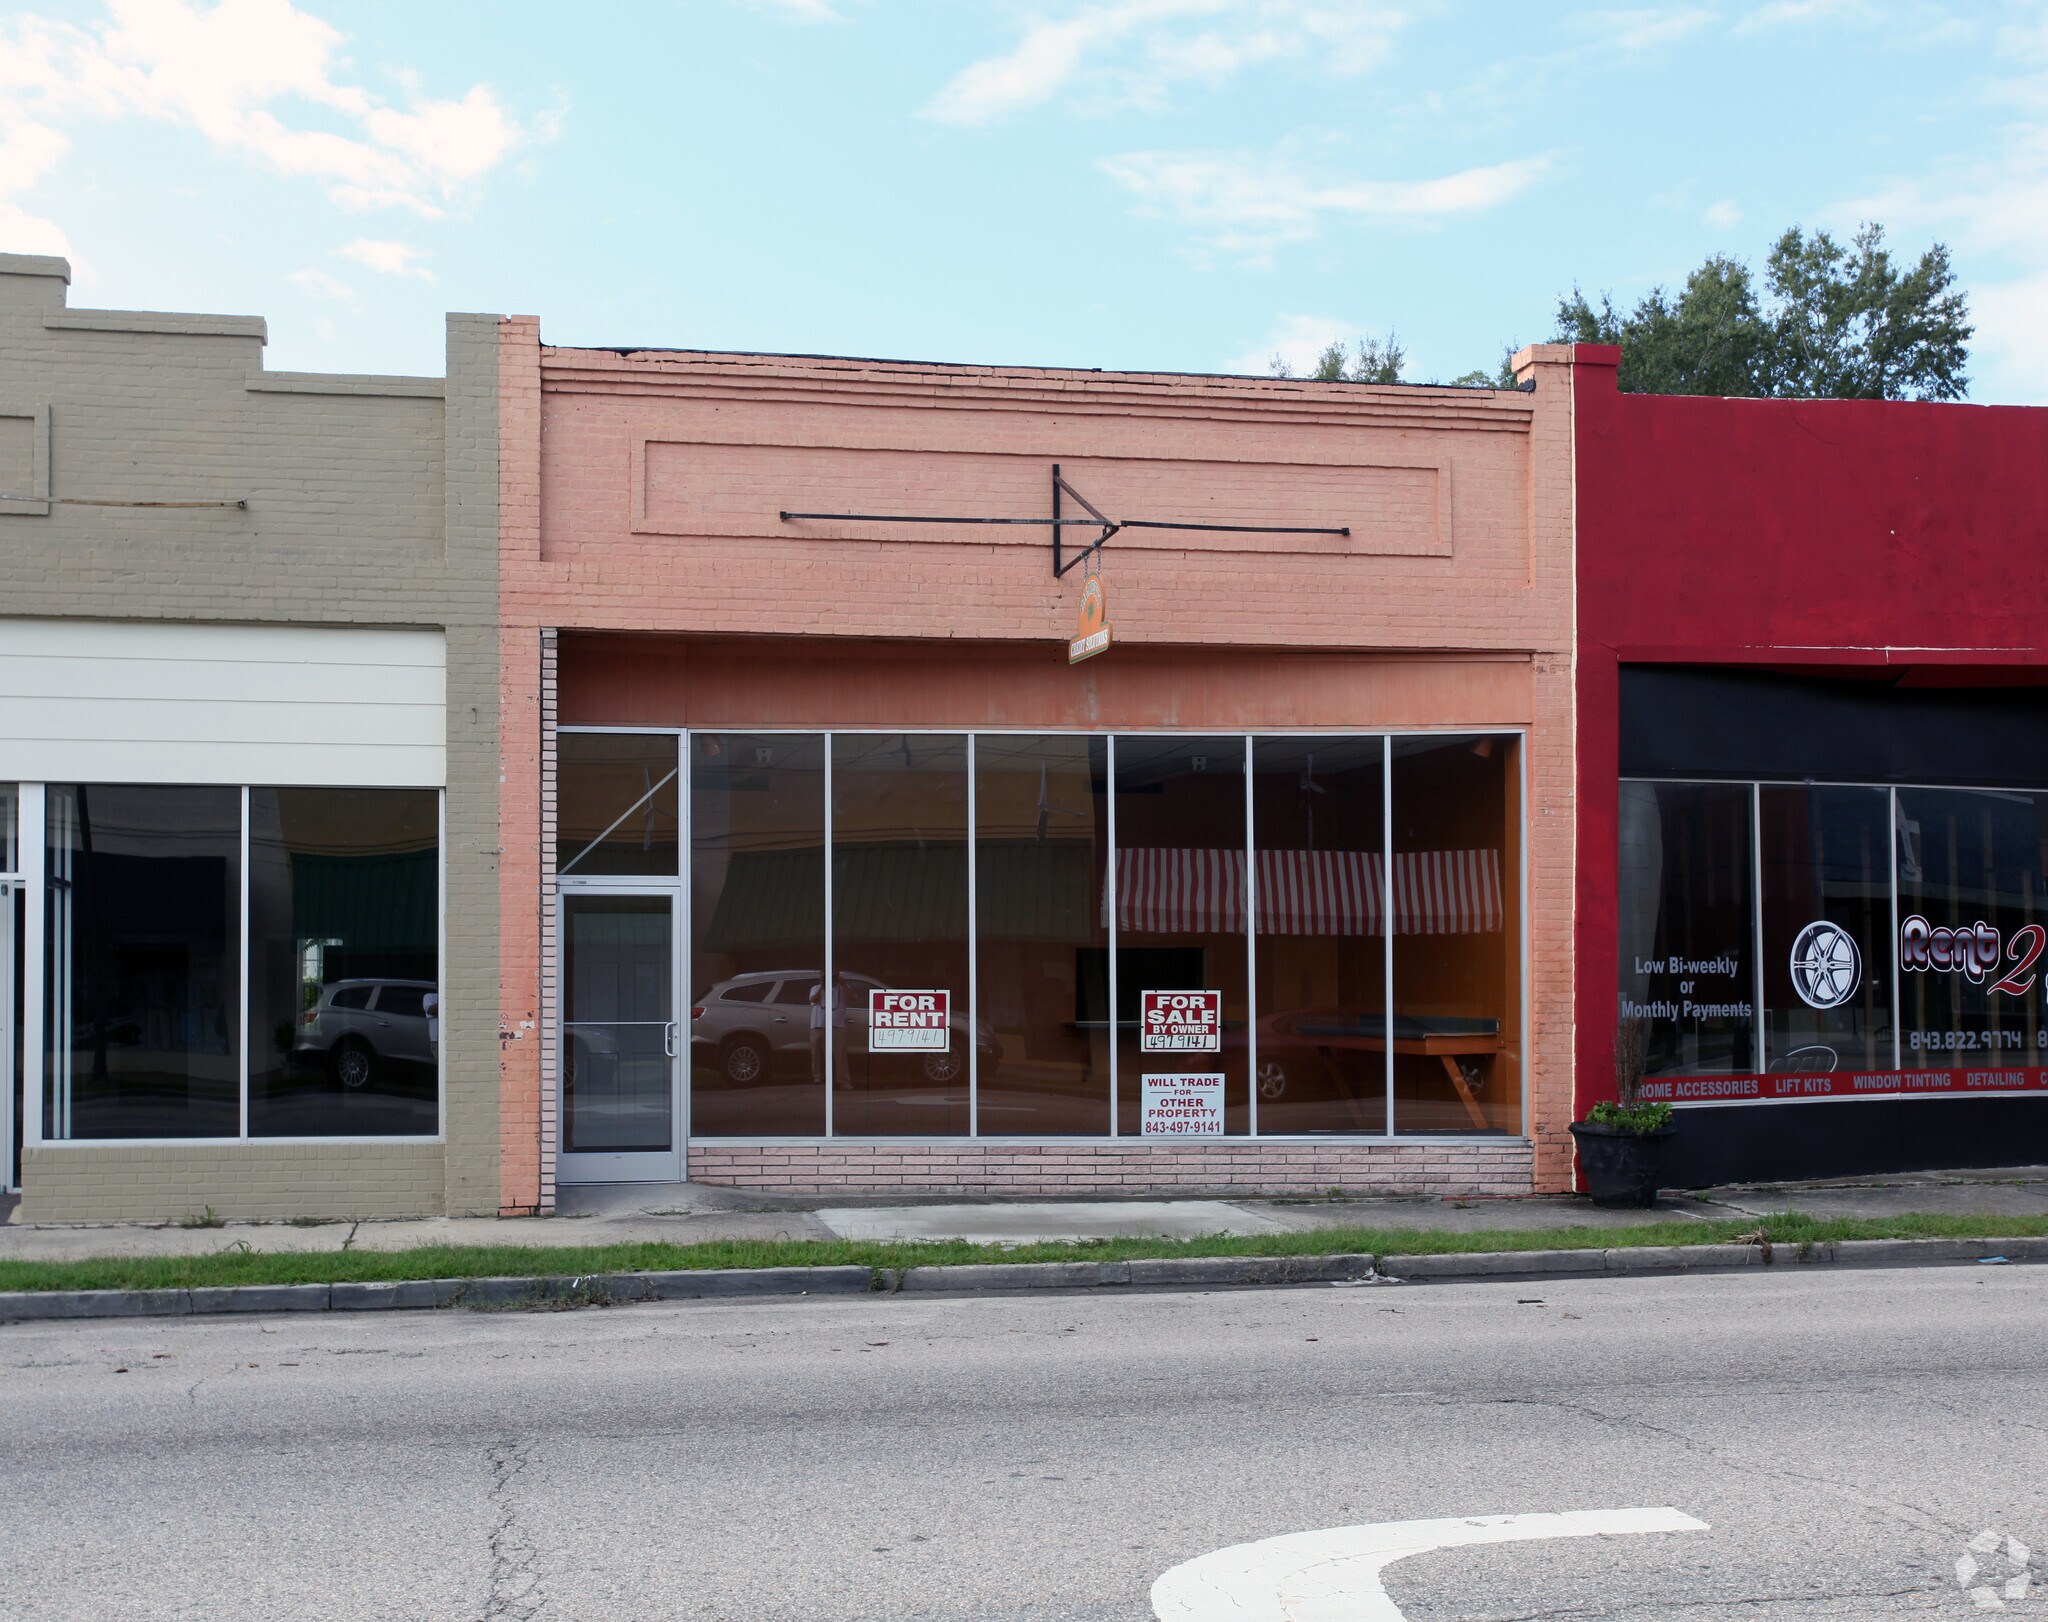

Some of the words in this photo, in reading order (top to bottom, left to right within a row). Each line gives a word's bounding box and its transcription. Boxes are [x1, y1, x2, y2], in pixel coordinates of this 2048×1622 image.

[1901, 915, 2000, 984] Rent
[1987, 924, 2046, 996] 2
[1635, 956, 1664, 974] Low
[1669, 956, 1738, 978] Bi-weekly
[1680, 981, 1695, 994] or
[884, 995, 935, 1011] FOR
[1156, 995, 1206, 1009] FOR
[1147, 1009, 1215, 1024] SALE
[1621, 1000, 1679, 1021] Monthly
[1683, 1000, 1752, 1021] Payments
[875, 1012, 944, 1027] RENT
[1153, 1025, 1168, 1034] BY
[1171, 1025, 1209, 1034] OWNER
[1910, 1030, 2022, 1050] 843.822.9774
[1147, 1078, 1177, 1087] WILL
[1180, 1078, 1220, 1086] TRADE
[1635, 1082, 1673, 1098] ROME
[1675, 1079, 1758, 1097] ACCESSORIES
[1775, 1078, 1801, 1093] LIFT
[1804, 1077, 1832, 1092] KITS
[1853, 1074, 1902, 1090] WINDOW
[1905, 1073, 1951, 1087] TINTING
[1967, 1072, 2025, 1086] DETAILING
[1160, 1098, 1204, 1107] OTHER
[1148, 1108, 1217, 1118] PROPERTY
[1145, 1121, 1220, 1133] 843-497-9141
